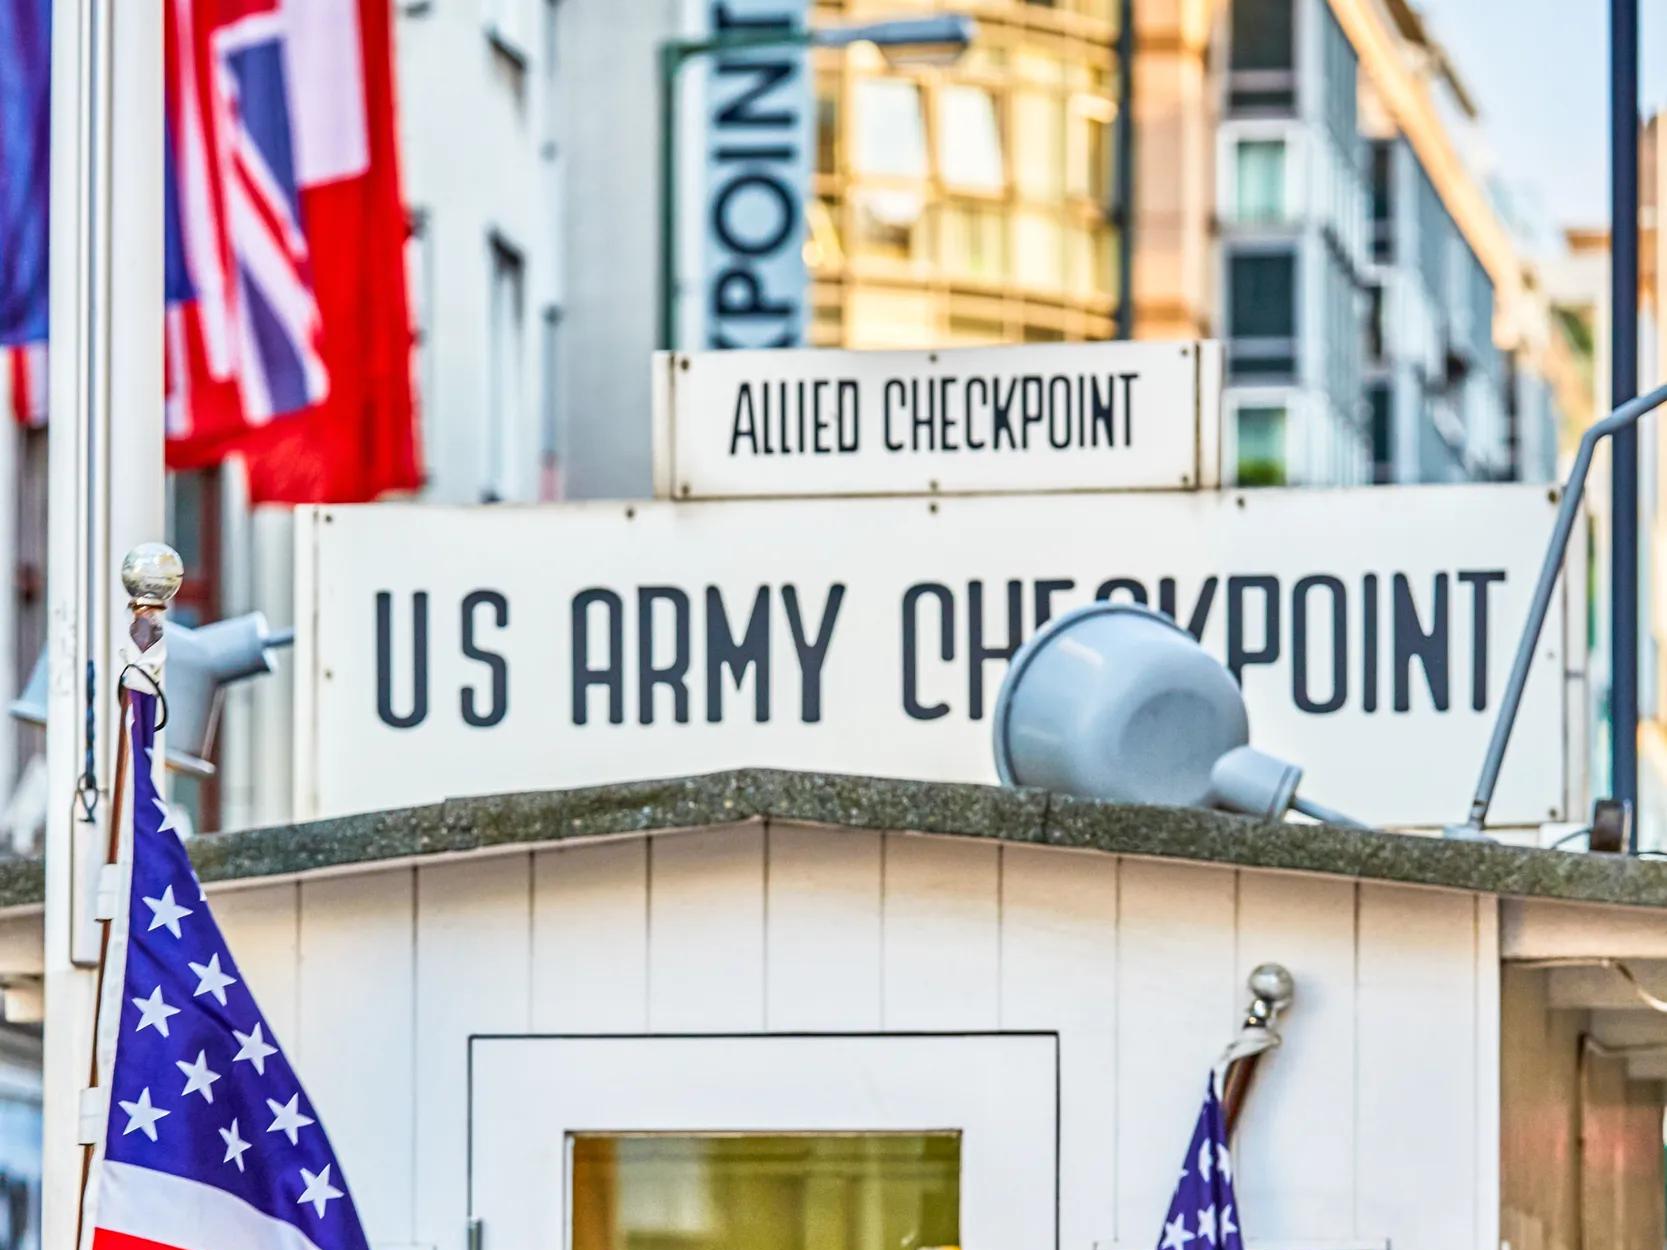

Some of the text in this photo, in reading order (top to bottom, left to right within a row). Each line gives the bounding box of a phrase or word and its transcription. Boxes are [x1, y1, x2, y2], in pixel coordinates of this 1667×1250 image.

[713, 3, 797, 349] POINT
[729, 373, 1140, 456] ALLIED CHECKPOINT
[375, 571, 1506, 728] US ARMY CHPOINT
